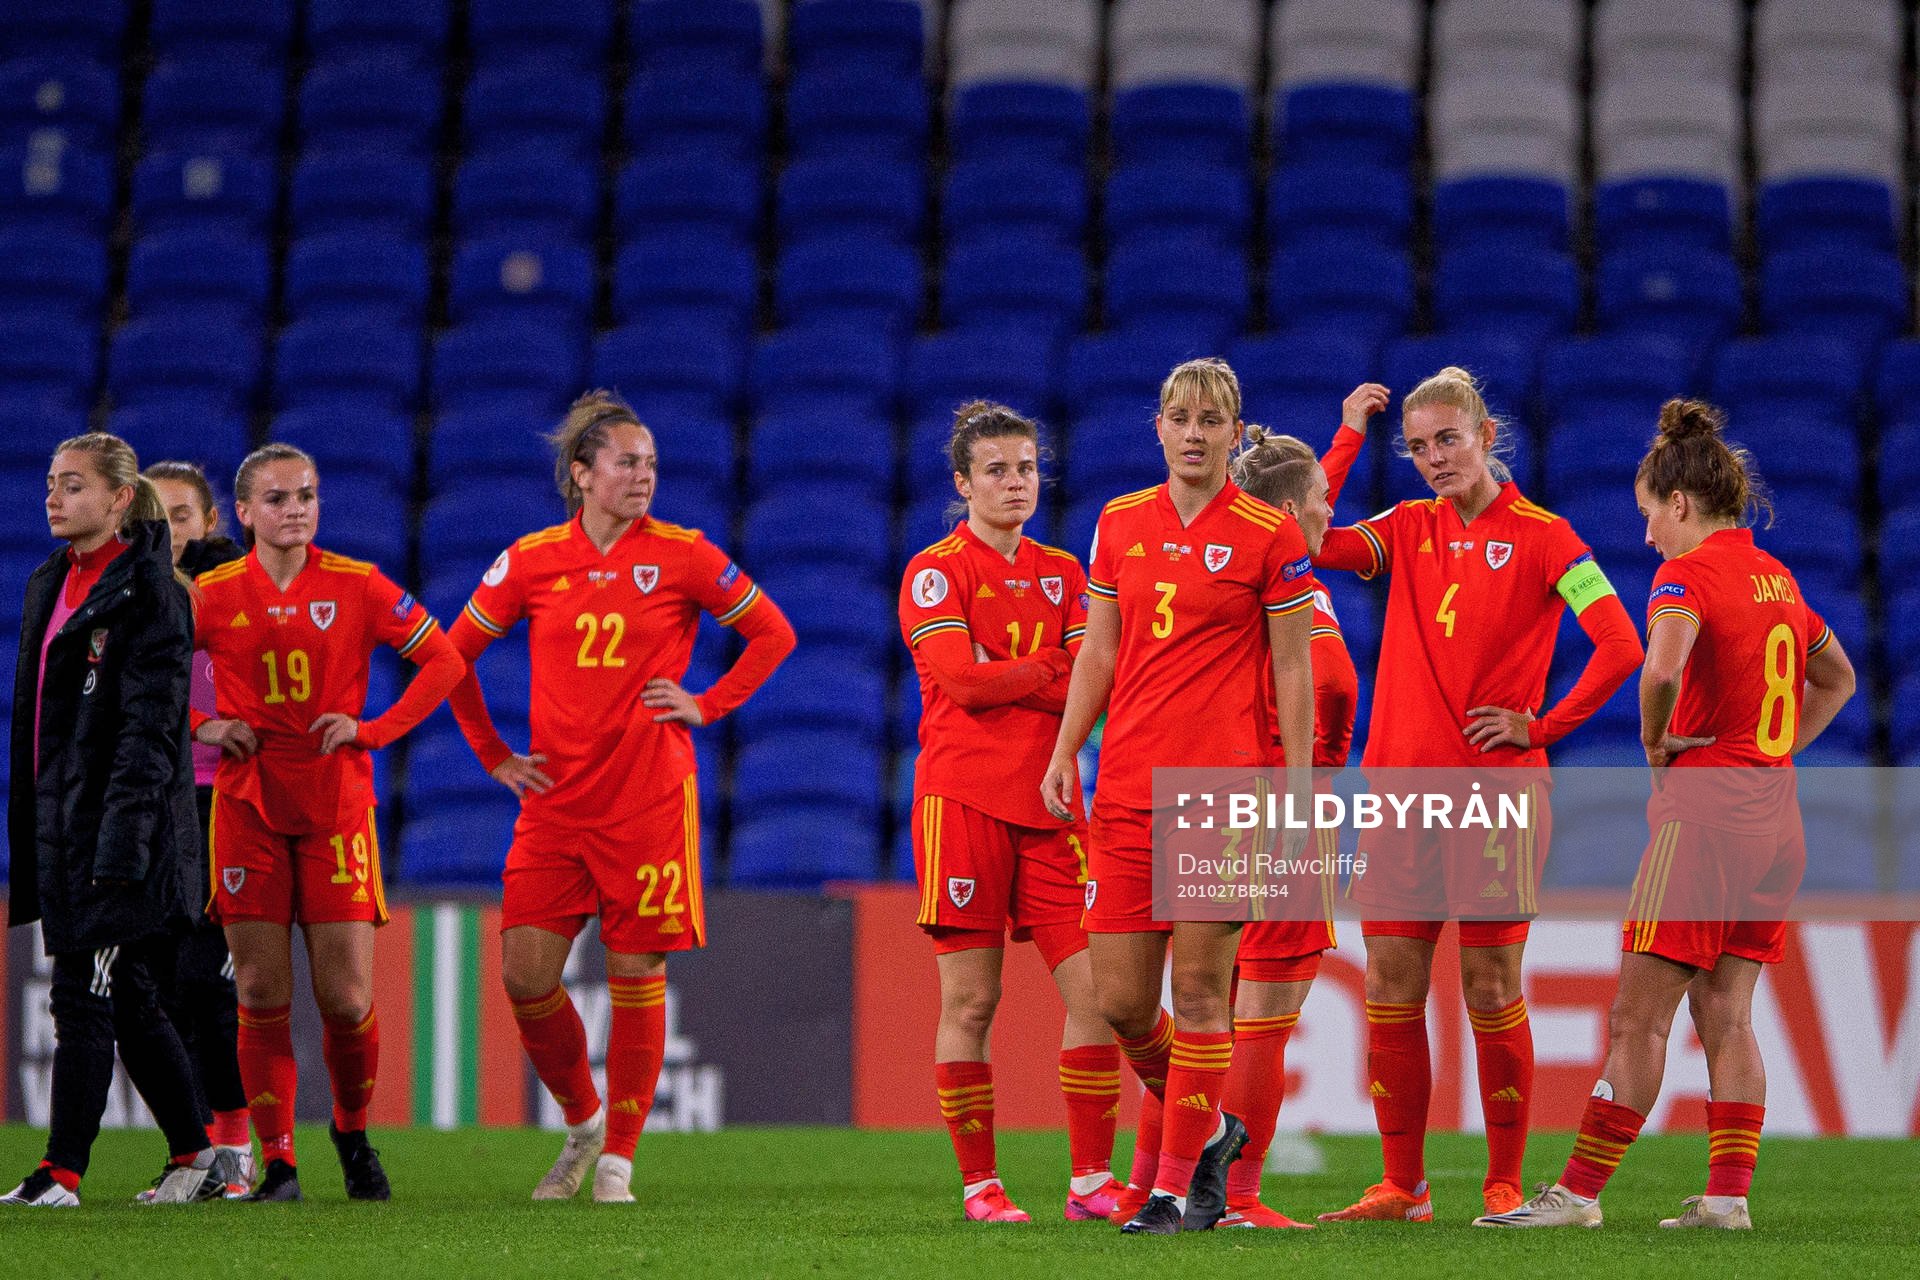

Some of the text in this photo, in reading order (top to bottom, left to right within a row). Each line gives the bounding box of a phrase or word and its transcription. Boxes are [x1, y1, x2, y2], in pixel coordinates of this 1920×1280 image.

[1151, 581, 1178, 639] 3
[1435, 582, 1460, 638] 4
[1750, 574, 1796, 604] JAMES
[575, 612, 625, 668] 22
[262, 649, 311, 704] 19
[1756, 623, 1796, 757] 8
[329, 832, 369, 884] 19
[1218, 827, 1243, 881] 3
[1483, 816, 1506, 872] 4
[636, 860, 685, 917] 22
